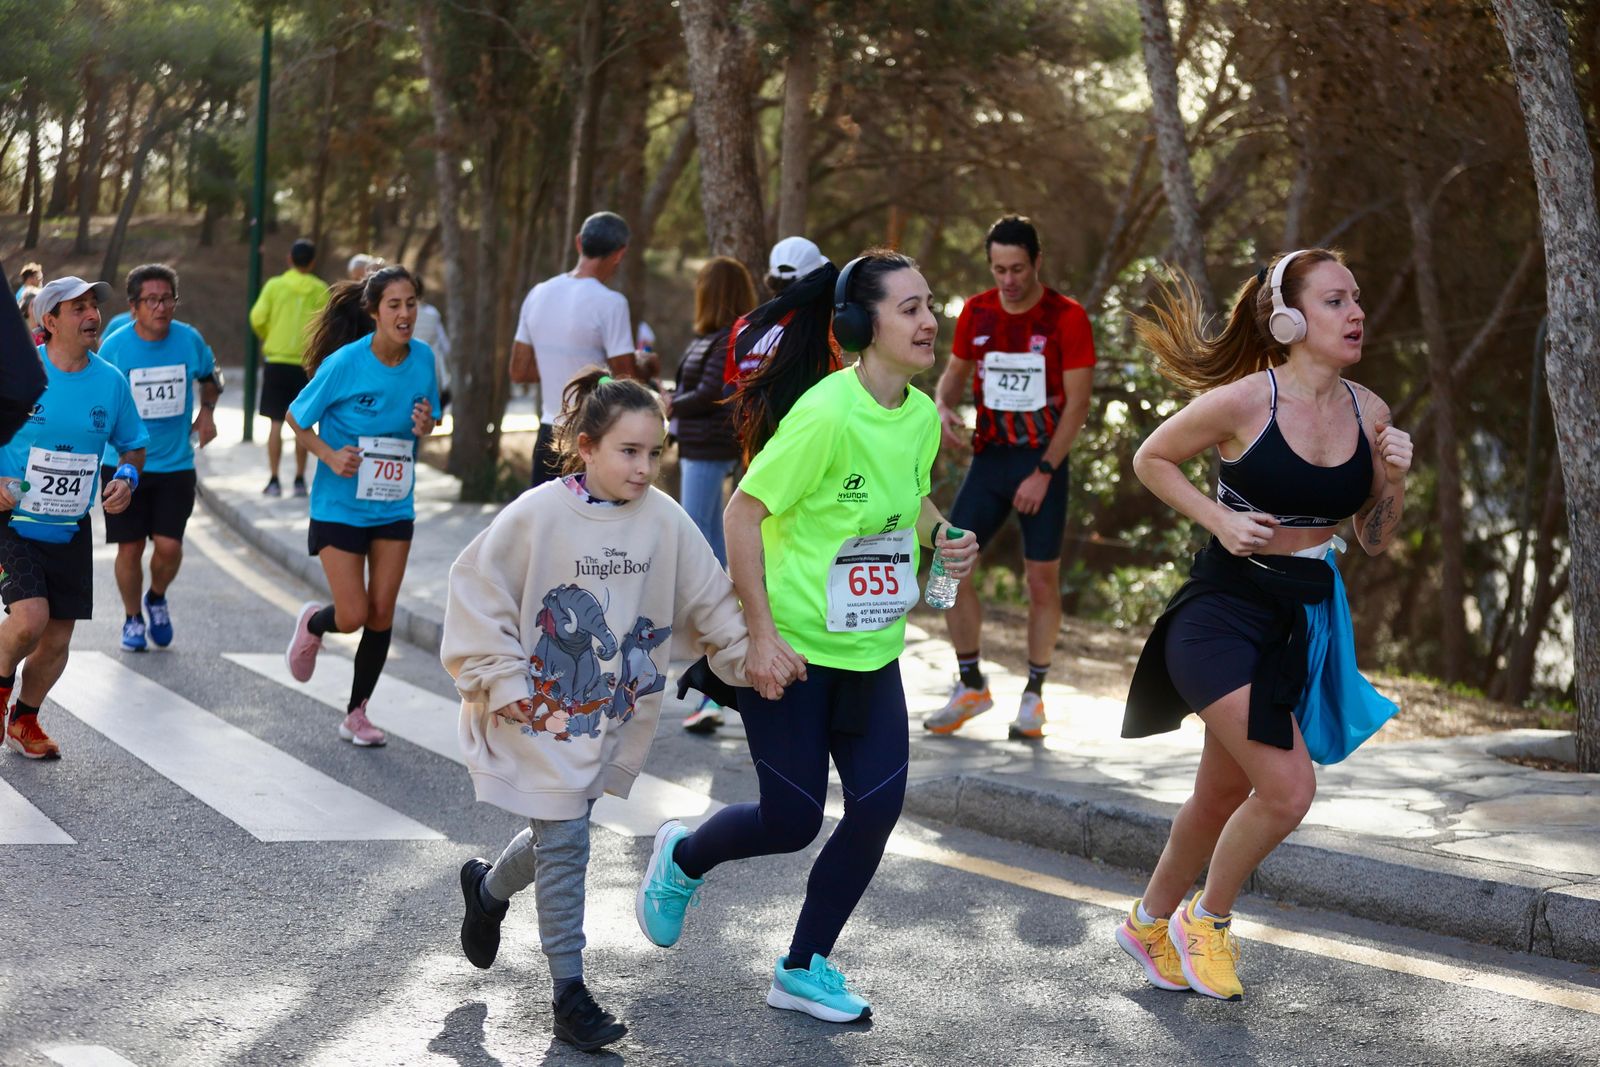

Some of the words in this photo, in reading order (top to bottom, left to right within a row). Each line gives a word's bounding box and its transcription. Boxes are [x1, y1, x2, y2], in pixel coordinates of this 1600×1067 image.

[998, 373, 1031, 392] 427
[145, 385, 176, 401] 141
[374, 460, 403, 481] 703
[40, 475, 81, 496] 284
[583, 556, 598, 564] The
[602, 547, 628, 559] Disney
[574, 559, 621, 580] Jungle
[849, 566, 899, 596] 655
